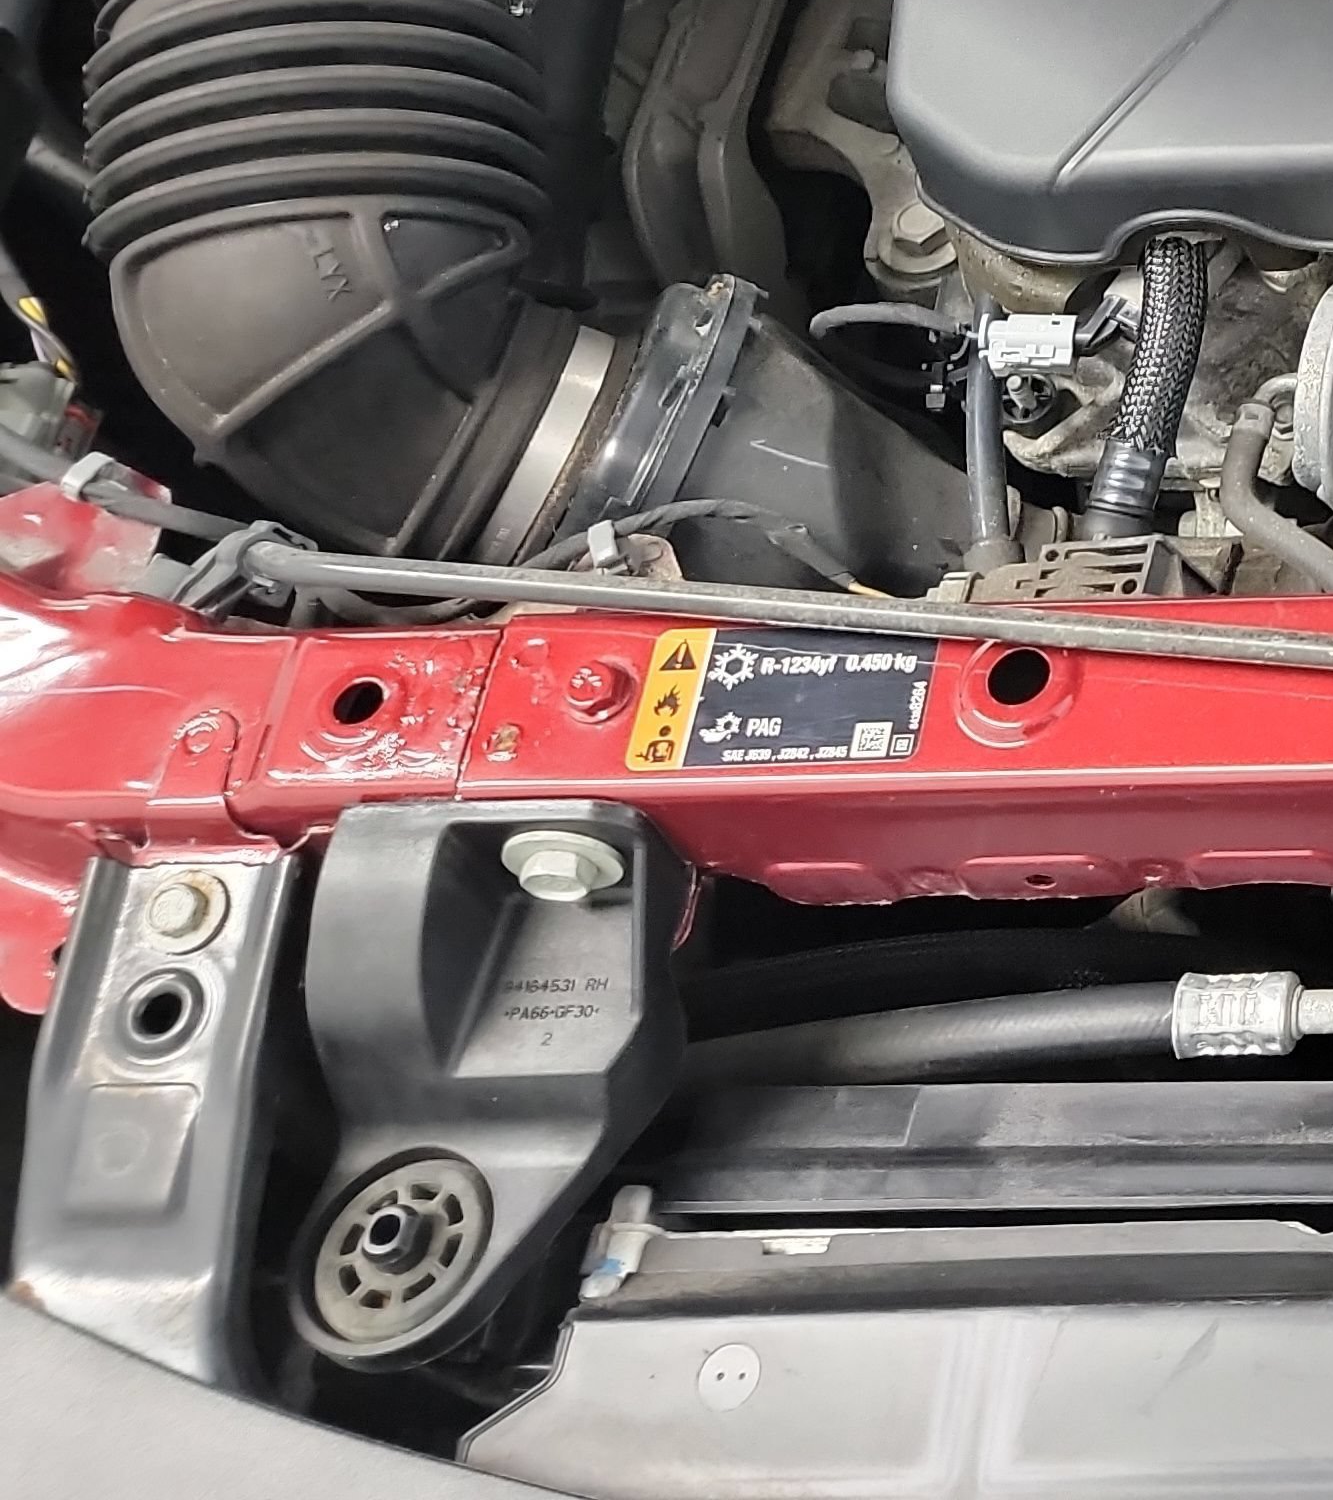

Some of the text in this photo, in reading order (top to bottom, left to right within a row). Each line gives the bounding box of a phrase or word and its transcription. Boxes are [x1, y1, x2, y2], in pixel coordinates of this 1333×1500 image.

[760, 655, 837, 676] R-1234yf
[893, 653, 918, 674] kg
[745, 717, 783, 738] PAG
[585, 978, 609, 991] RH
[540, 1032, 553, 1046] 2
